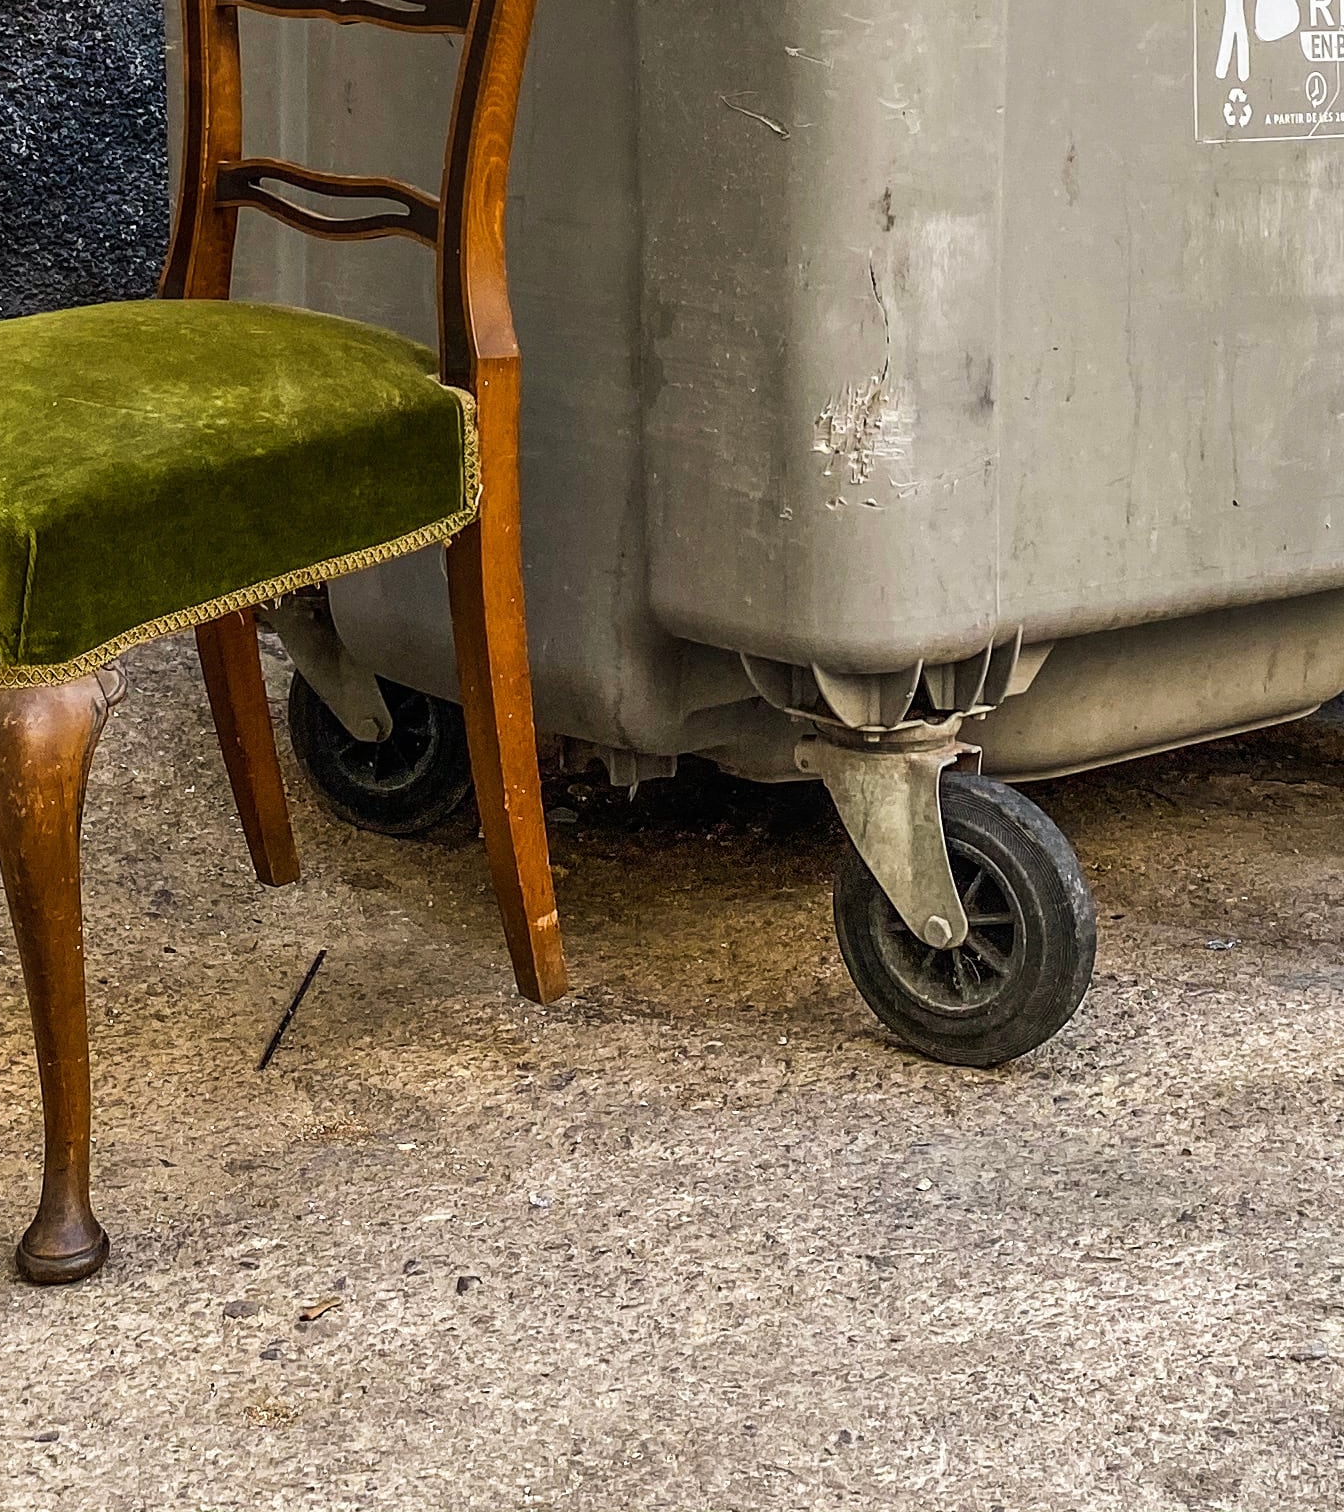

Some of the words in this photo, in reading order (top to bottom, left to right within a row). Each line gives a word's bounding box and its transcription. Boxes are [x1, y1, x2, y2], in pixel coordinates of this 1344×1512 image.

[1311, 34, 1333, 59] EN
[1265, 113, 1272, 124] A
[1273, 112, 1304, 124] PARTIR
[1306, 112, 1317, 123] DE
